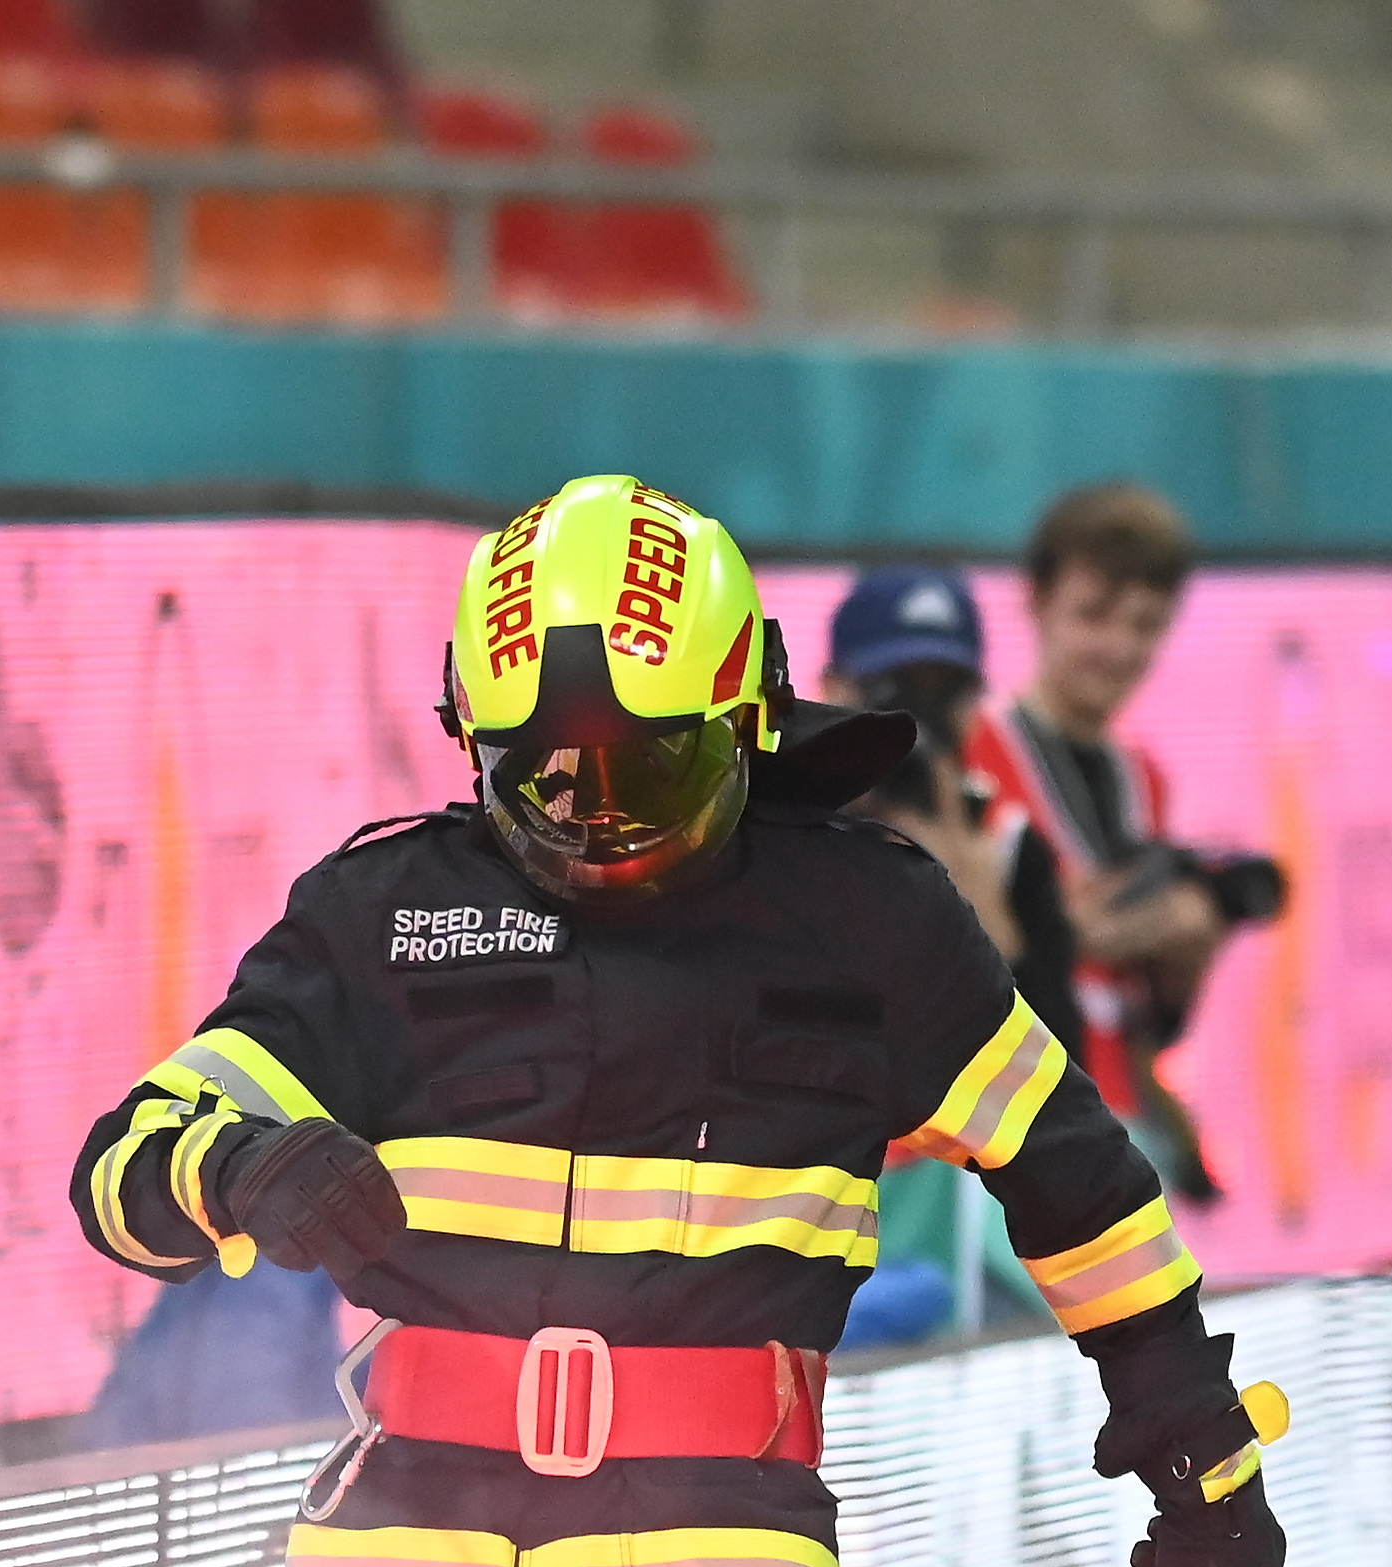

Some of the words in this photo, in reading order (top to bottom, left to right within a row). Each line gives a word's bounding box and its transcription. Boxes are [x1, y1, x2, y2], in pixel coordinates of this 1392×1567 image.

[487, 560, 539, 680] FIRE
[608, 517, 688, 667] SPEED
[390, 930, 556, 962] PROTECTION
[394, 906, 483, 935] SPEED
[499, 907, 560, 934] FIRE
